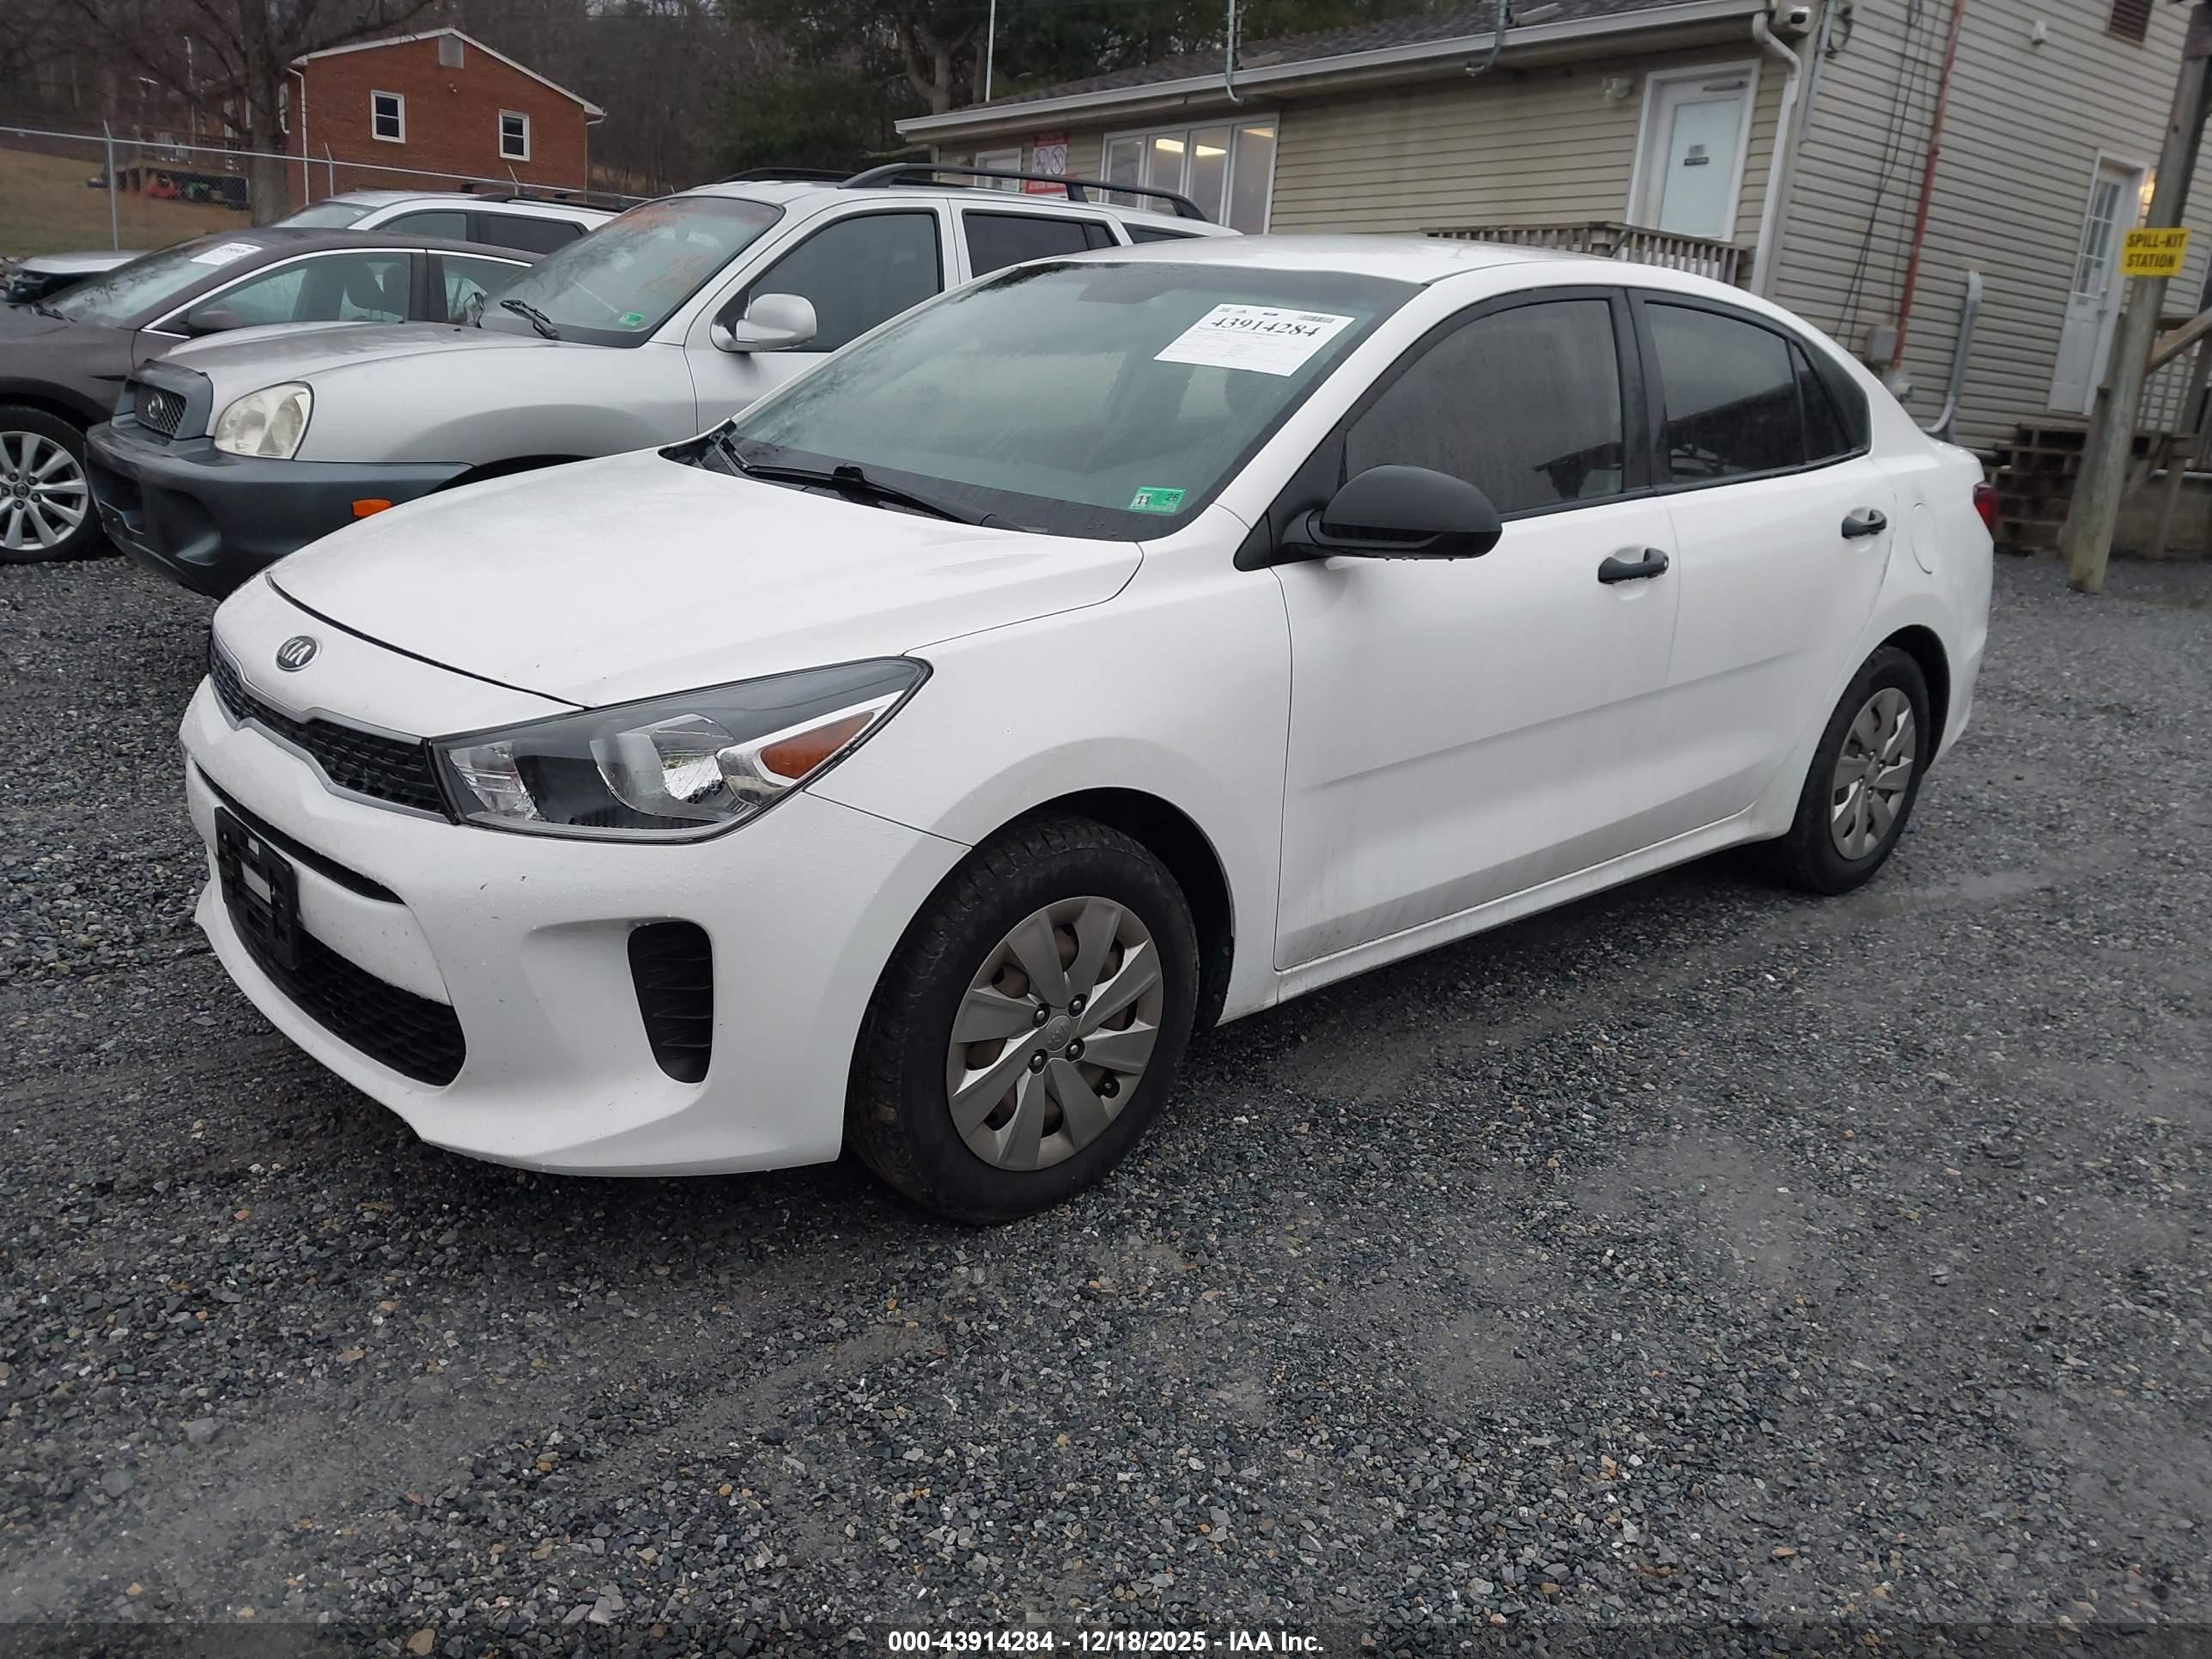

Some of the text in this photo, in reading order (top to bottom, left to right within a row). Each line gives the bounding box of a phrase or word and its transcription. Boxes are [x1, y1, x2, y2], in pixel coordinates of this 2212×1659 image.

[2127, 233, 2186, 248] SPILL-KIT
[2126, 253, 2177, 267] STATION
[1211, 316, 1322, 337] 43914284
